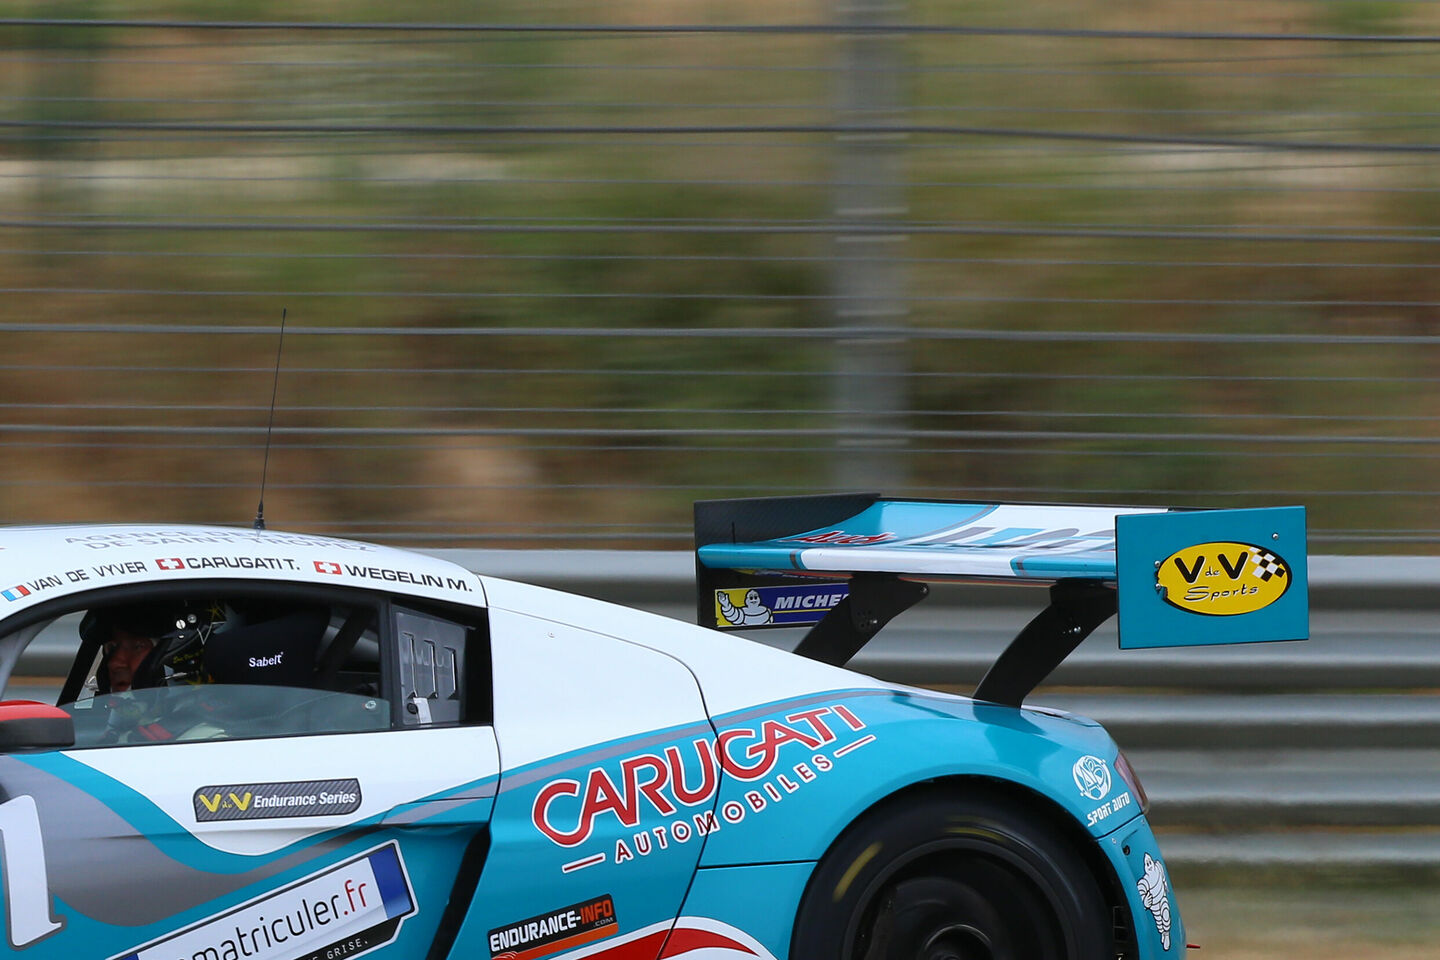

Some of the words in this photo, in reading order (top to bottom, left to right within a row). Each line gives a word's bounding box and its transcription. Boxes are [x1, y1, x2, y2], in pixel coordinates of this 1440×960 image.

[64, 531, 200, 544] AGENCE
[82, 540, 133, 550] DE
[137, 536, 235, 545] SAINT
[185, 557, 281, 570] CARUGATI
[1174, 555, 1205, 584] V
[1218, 551, 1248, 580] V
[26, 575, 64, 592] VAN
[65, 569, 91, 583] DE
[93, 561, 148, 577] VYVER
[344, 564, 444, 589] WEGELIN
[447, 577, 473, 592] M.
[774, 593, 850, 609] MICHE
[1183, 583, 1259, 602] Sports
[248, 653, 282, 668] Sabelt
[532, 704, 867, 848] CARUGATI
[199, 793, 222, 813] V
[229, 792, 252, 811] V
[253, 792, 316, 809] Endurance
[319, 790, 357, 805] Series
[614, 754, 832, 863] AUTOMOBILES
[1086, 802, 1112, 827] SPORT
[1111, 791, 1131, 812] AUTO
[489, 899, 614, 952] ENDURANCE-INFO
[326, 938, 369, 960] GRISE.
